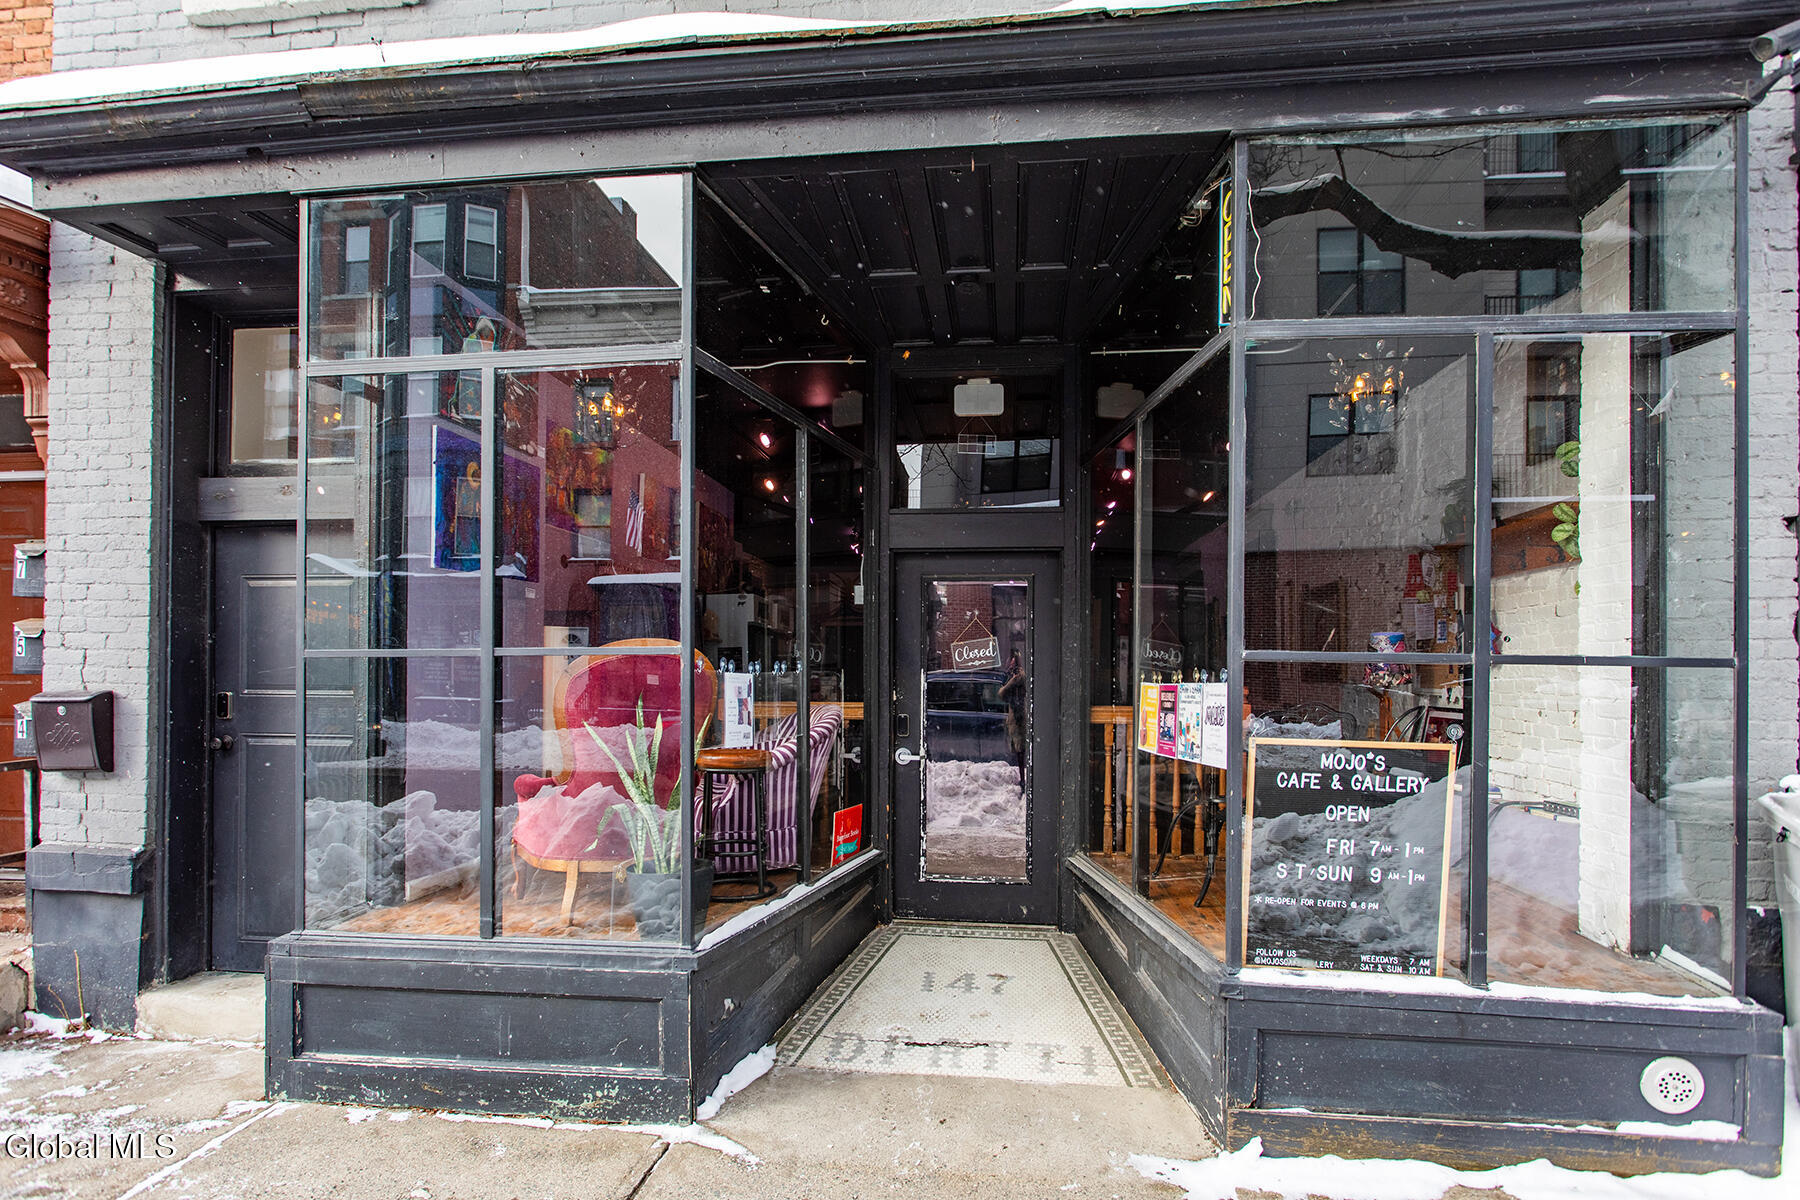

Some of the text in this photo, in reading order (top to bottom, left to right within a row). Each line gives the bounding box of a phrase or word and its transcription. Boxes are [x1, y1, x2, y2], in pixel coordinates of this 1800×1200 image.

[18, 560, 25, 578] 7
[17, 638, 24, 656] 5
[955, 641, 997, 662] Closed
[18, 719, 25, 738] 4
[1276, 772, 1430, 794] CAFE & GALLERY
[1325, 804, 1371, 823] OPEN
[1326, 838, 1355, 856] FRI
[1370, 867, 1382, 884] 9
[1264, 896, 1297, 906] RE-OPEN
[1300, 899, 1315, 907] FOR
[1317, 900, 1347, 909] EVENTS
[1255, 948, 1297, 958] FOLLOW US
[1360, 954, 1399, 965] WEEKDAYS
[1419, 959, 1431, 967] AM
[1360, 963, 1431, 976] SAT & SUN 10 AM
